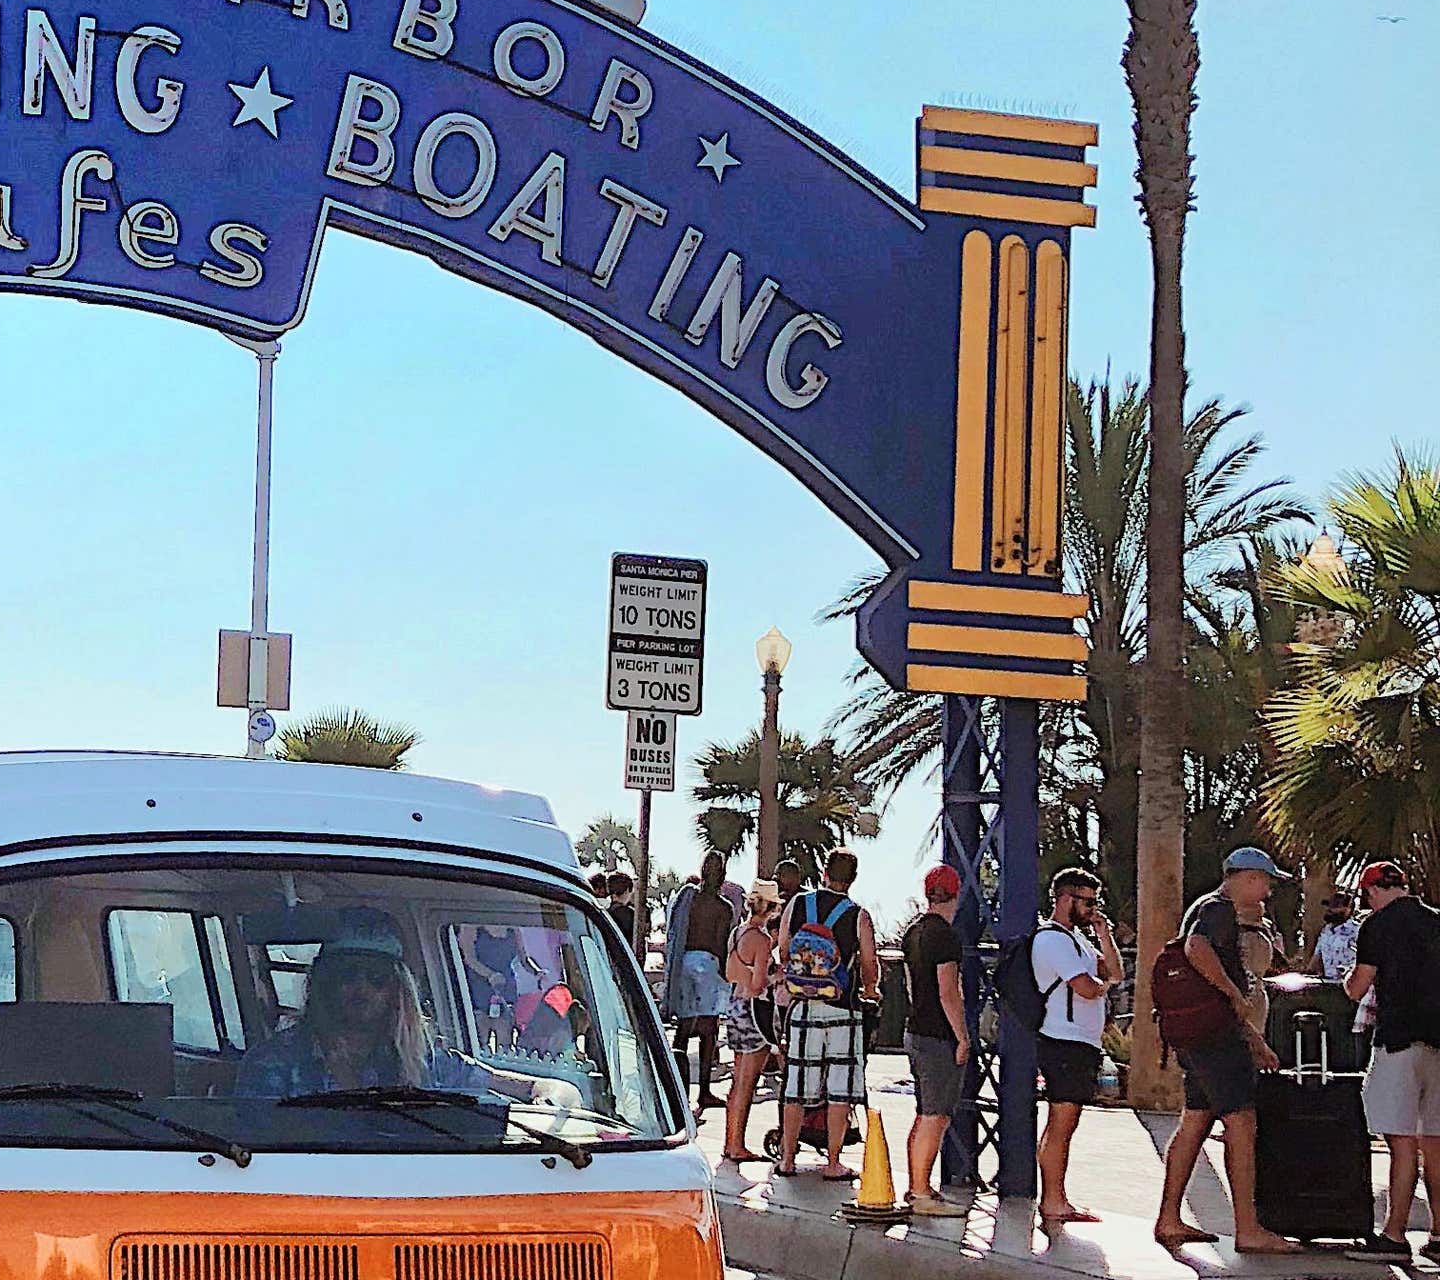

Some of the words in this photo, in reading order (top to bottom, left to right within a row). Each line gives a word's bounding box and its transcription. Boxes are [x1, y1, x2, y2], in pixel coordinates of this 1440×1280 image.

[327, 74, 843, 409] BOATING
[620, 565, 646, 575] SANTA
[648, 567, 678, 577] MONICA
[681, 570, 698, 579] PIER
[620, 584, 662, 598] WEIGHT
[667, 588, 697, 600] LIMIT
[619, 605, 638, 625] 10
[645, 607, 696, 630] TONS
[616, 639, 636, 649] PIER
[638, 641, 675, 651] PARKING
[679, 644, 695, 653] LOT
[616, 658, 659, 673] WEIGHT
[664, 662, 694, 675] LIMIT
[617, 678, 629, 697] 3
[637, 680, 690, 702] TONS
[636, 718, 667, 745] NO
[630, 748, 671, 763] BUSES
